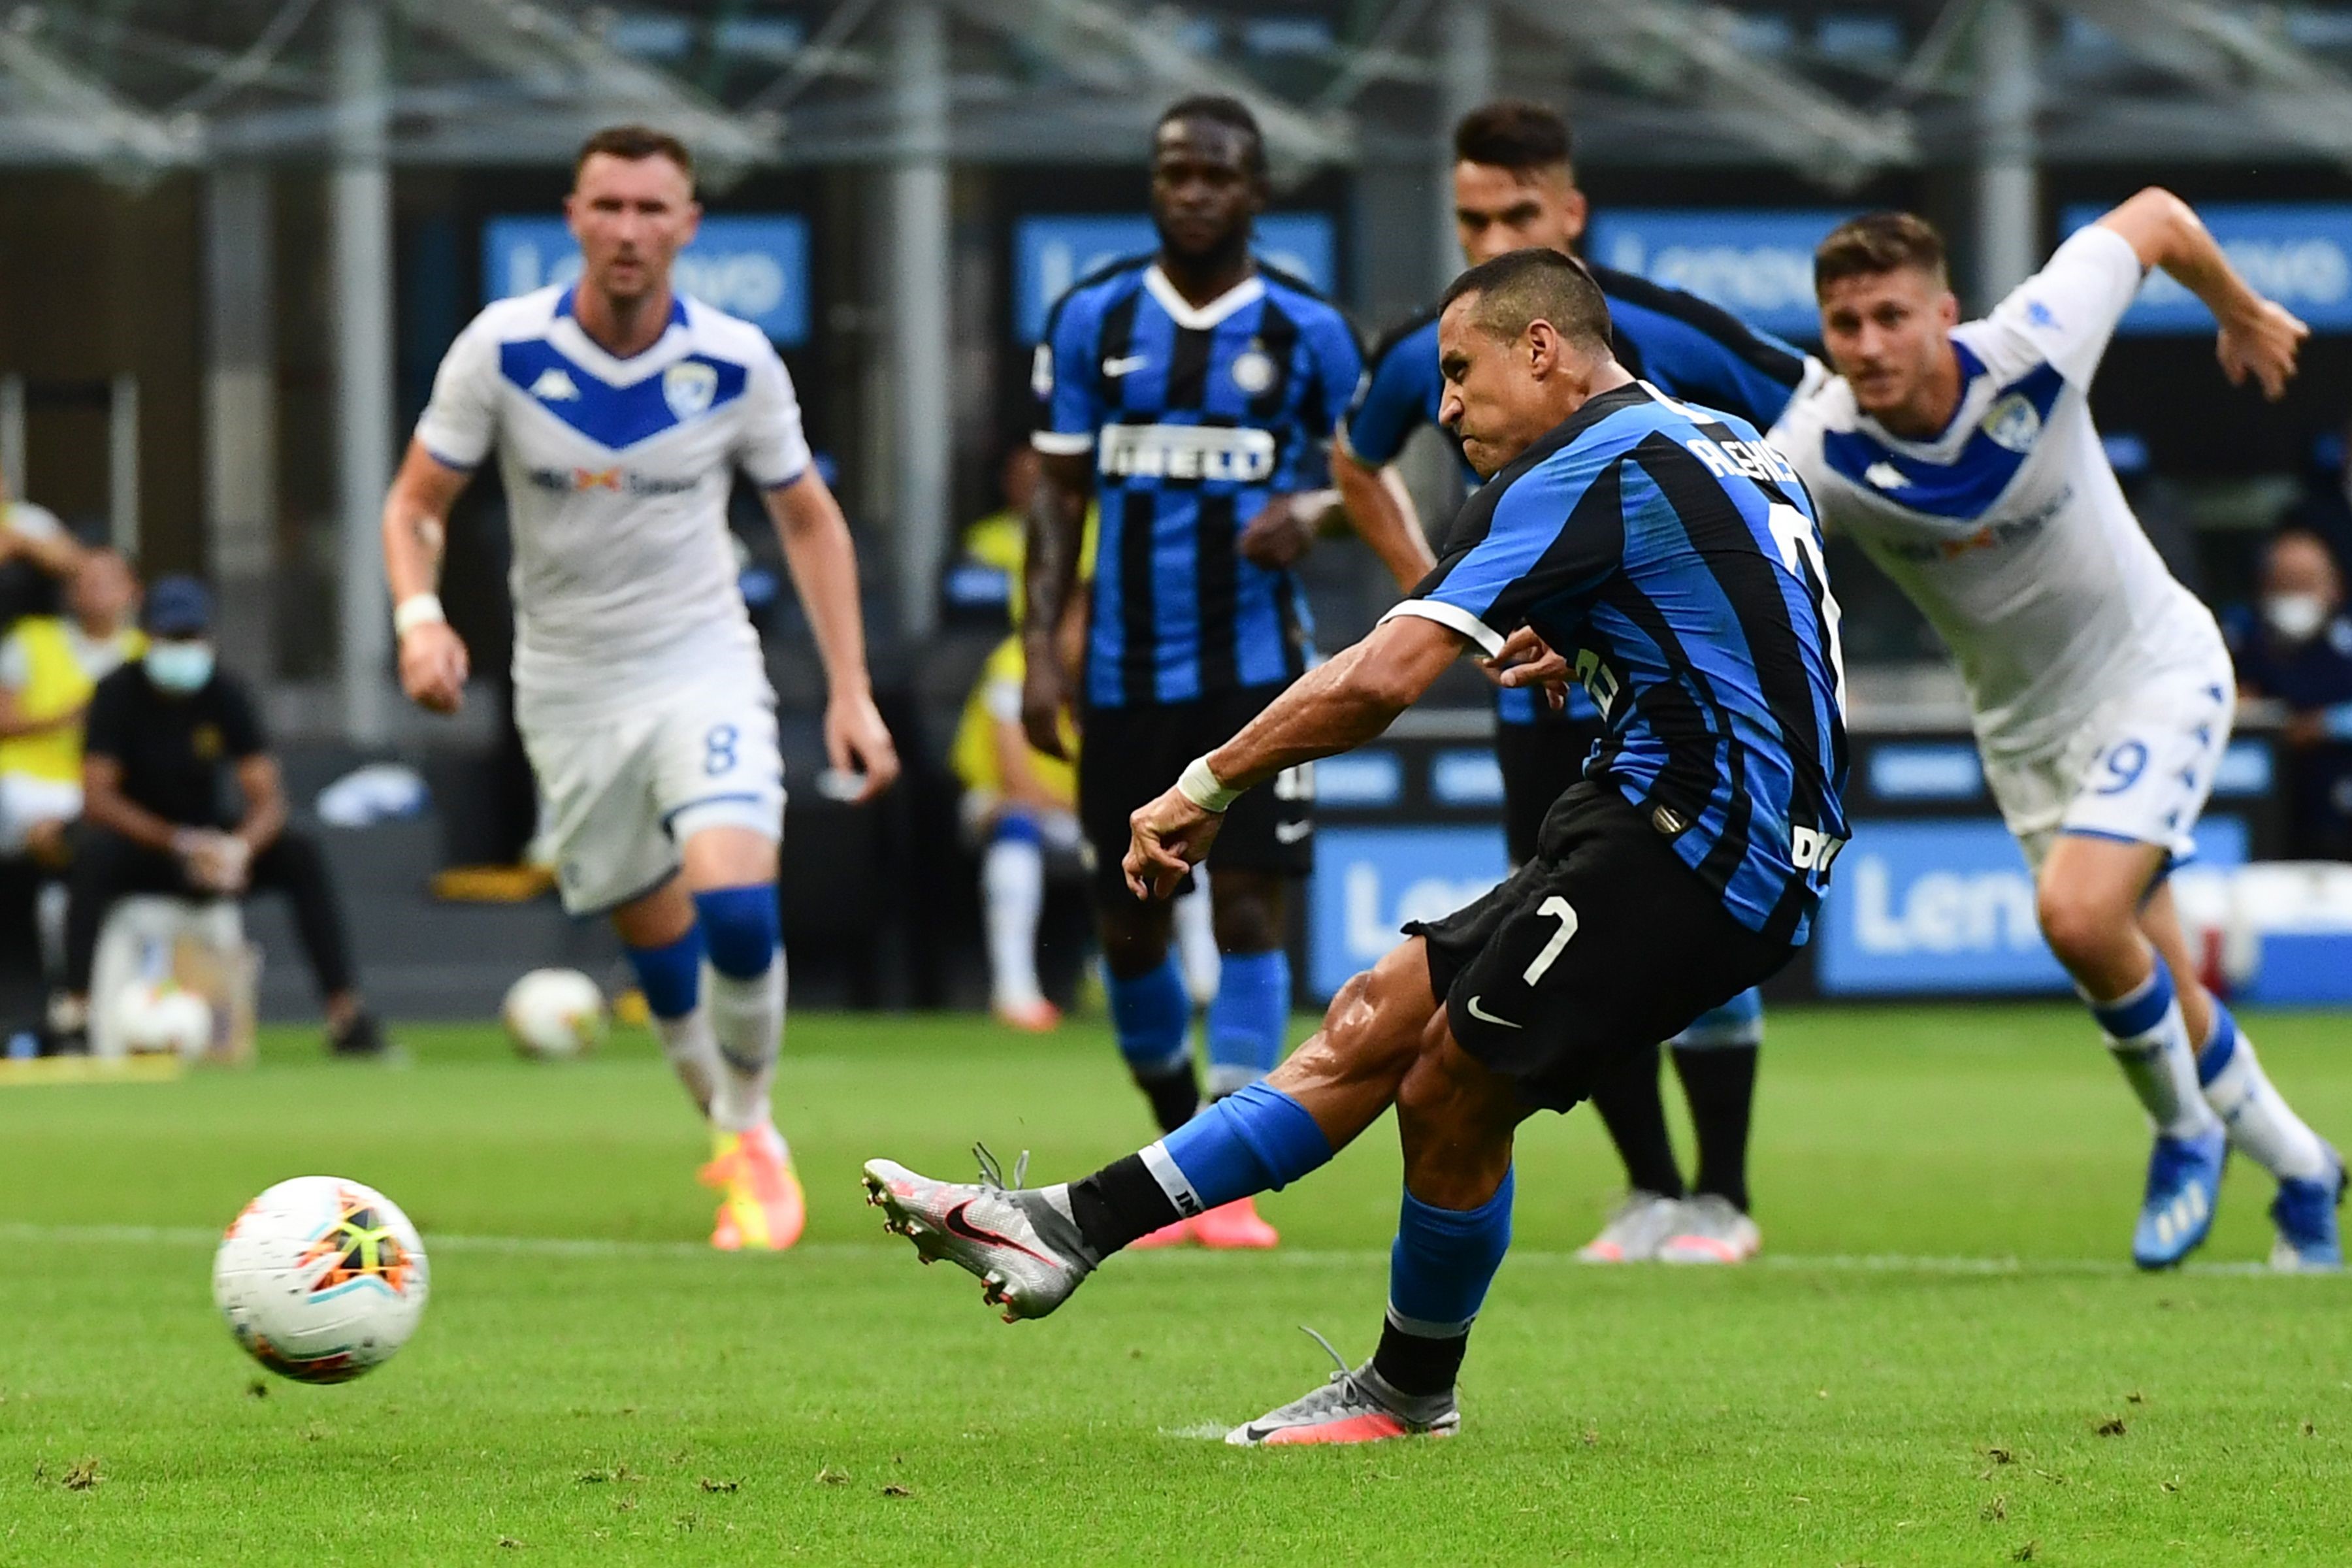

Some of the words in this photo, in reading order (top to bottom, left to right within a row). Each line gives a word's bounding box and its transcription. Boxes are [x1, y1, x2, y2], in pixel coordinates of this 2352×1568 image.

[1686, 438, 1798, 483] ALEXIS
[704, 722, 740, 777] 8
[1522, 896, 1578, 987] 7
